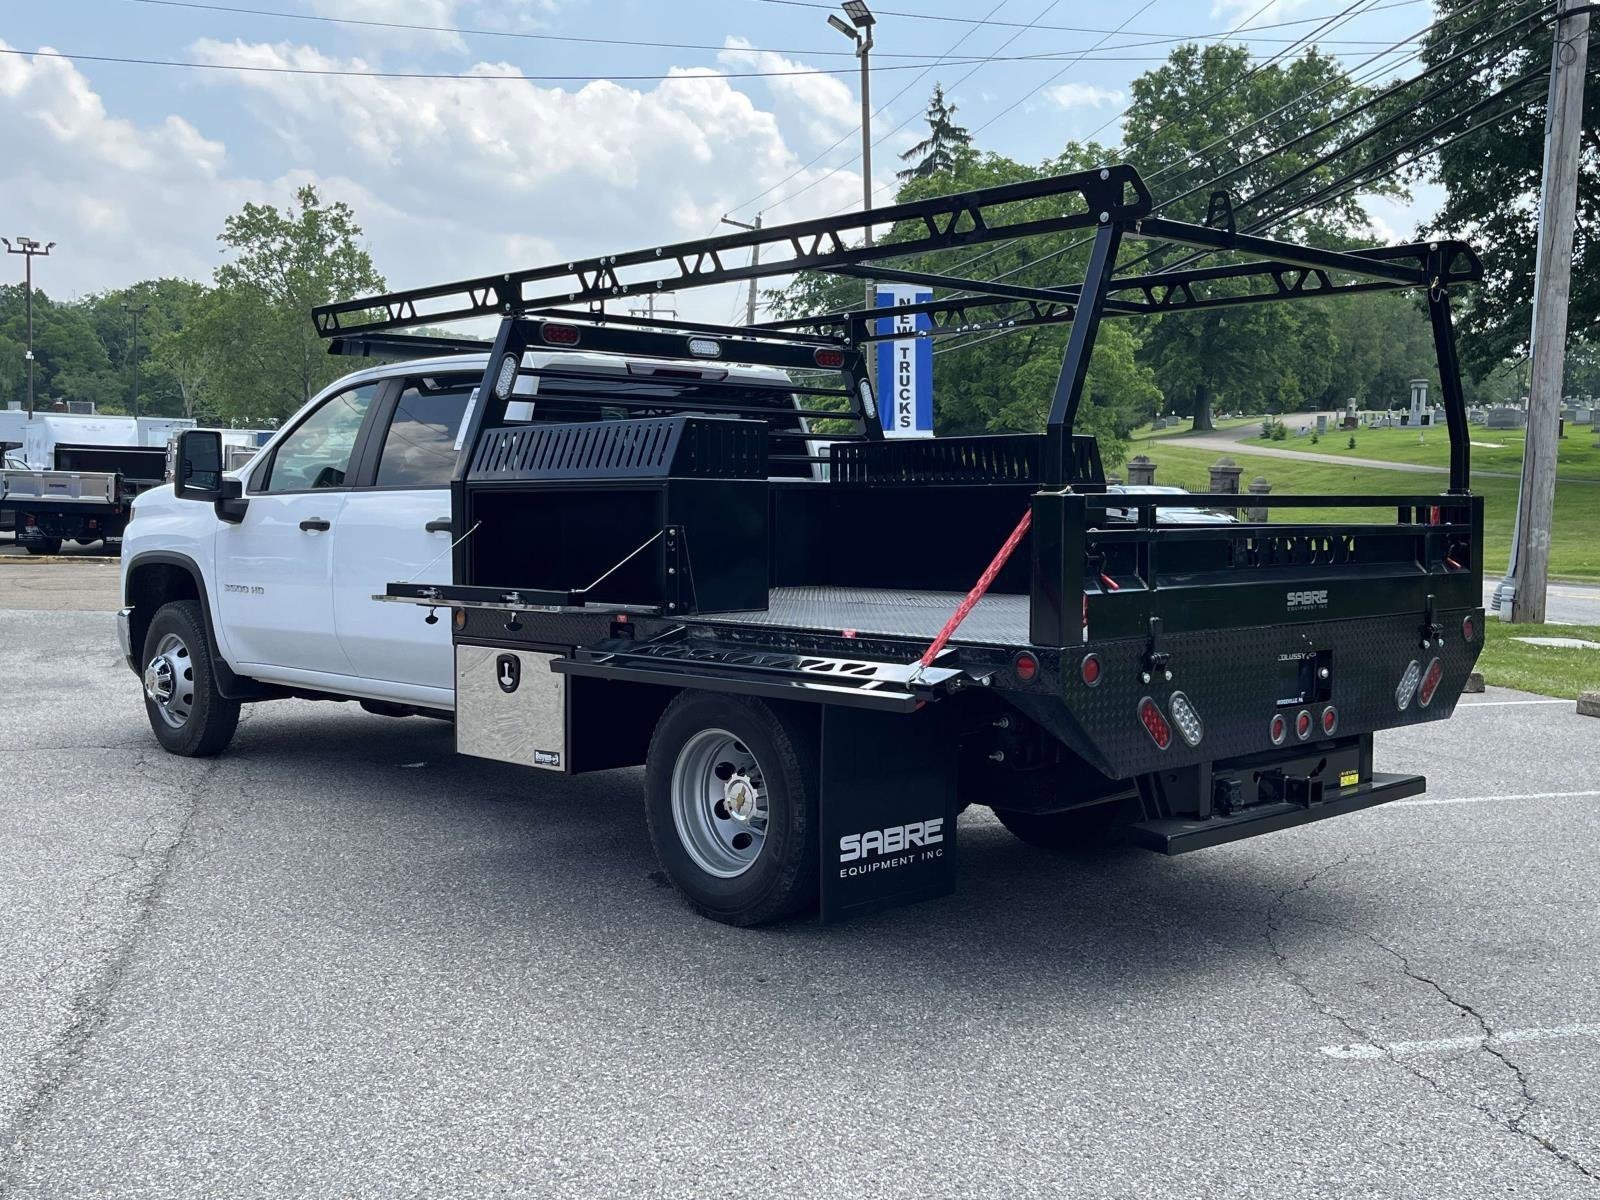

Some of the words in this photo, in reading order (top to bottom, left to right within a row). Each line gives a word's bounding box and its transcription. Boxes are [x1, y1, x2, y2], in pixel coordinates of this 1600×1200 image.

[896, 298, 913, 334] NEW
[899, 347, 911, 428] TRUCKS
[224, 584, 249, 593] 3500
[251, 586, 264, 594] HD
[1287, 590, 1328, 606] SABRE
[840, 818, 944, 862] SABRE
[840, 855, 915, 878] EQUIPMENT
[921, 849, 943, 860] INC
